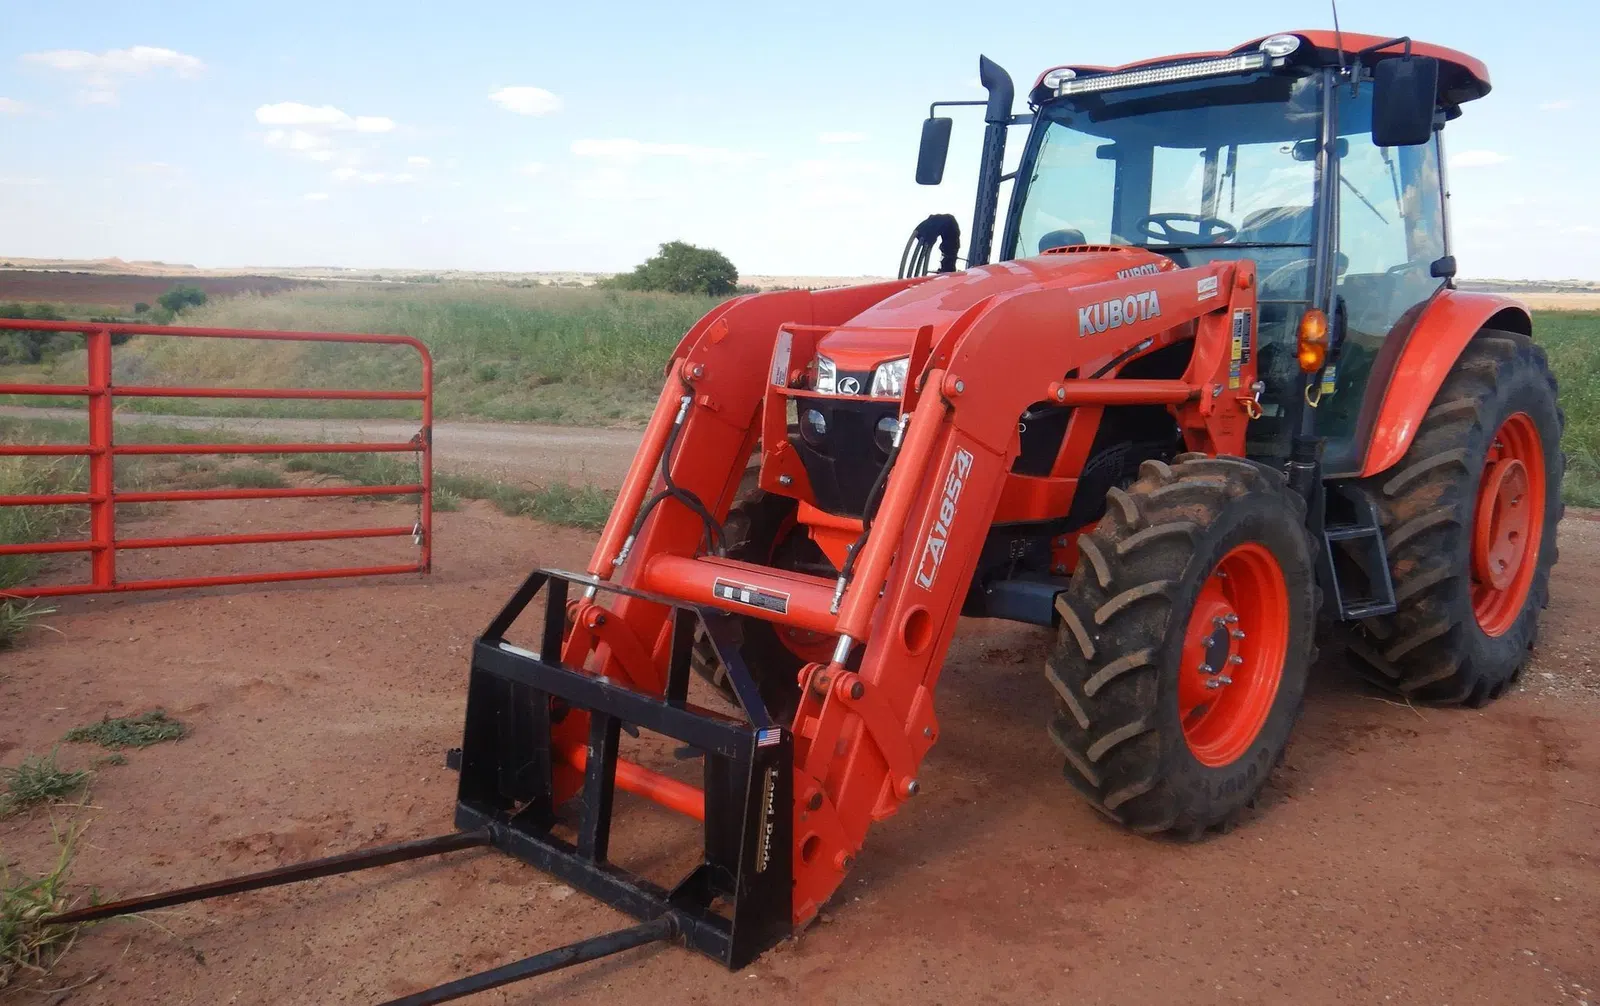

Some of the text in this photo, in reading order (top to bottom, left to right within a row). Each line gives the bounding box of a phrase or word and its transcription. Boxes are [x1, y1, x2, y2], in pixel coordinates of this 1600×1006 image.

[1078, 290, 1161, 337] KUBOTA
[919, 449, 969, 588] LA1854
[761, 768, 779, 871] Land Pride
